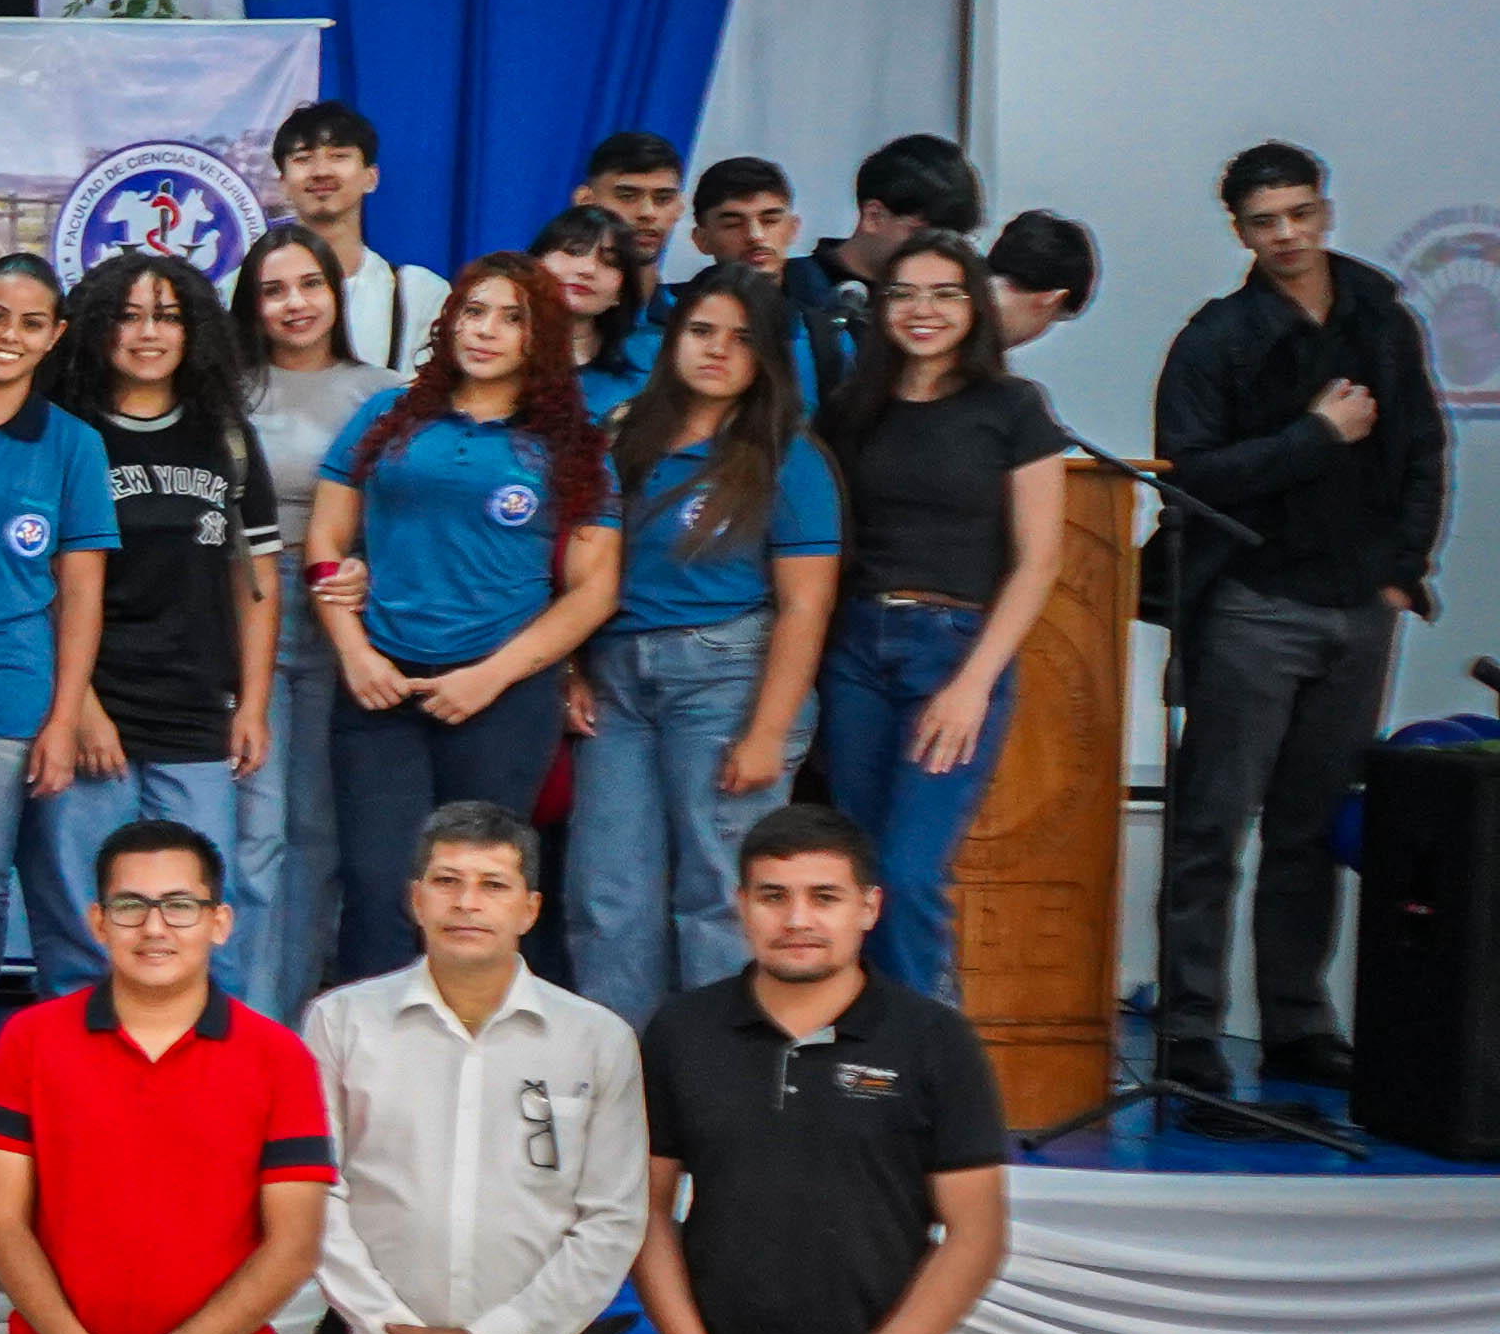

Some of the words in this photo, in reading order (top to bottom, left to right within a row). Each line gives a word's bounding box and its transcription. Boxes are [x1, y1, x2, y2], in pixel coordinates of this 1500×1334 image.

[64, 178, 105, 247] FACULTAD
[104, 162, 126, 181] DE
[127, 151, 196, 169] CIENCIAS
[153, 465, 228, 508] YORK
